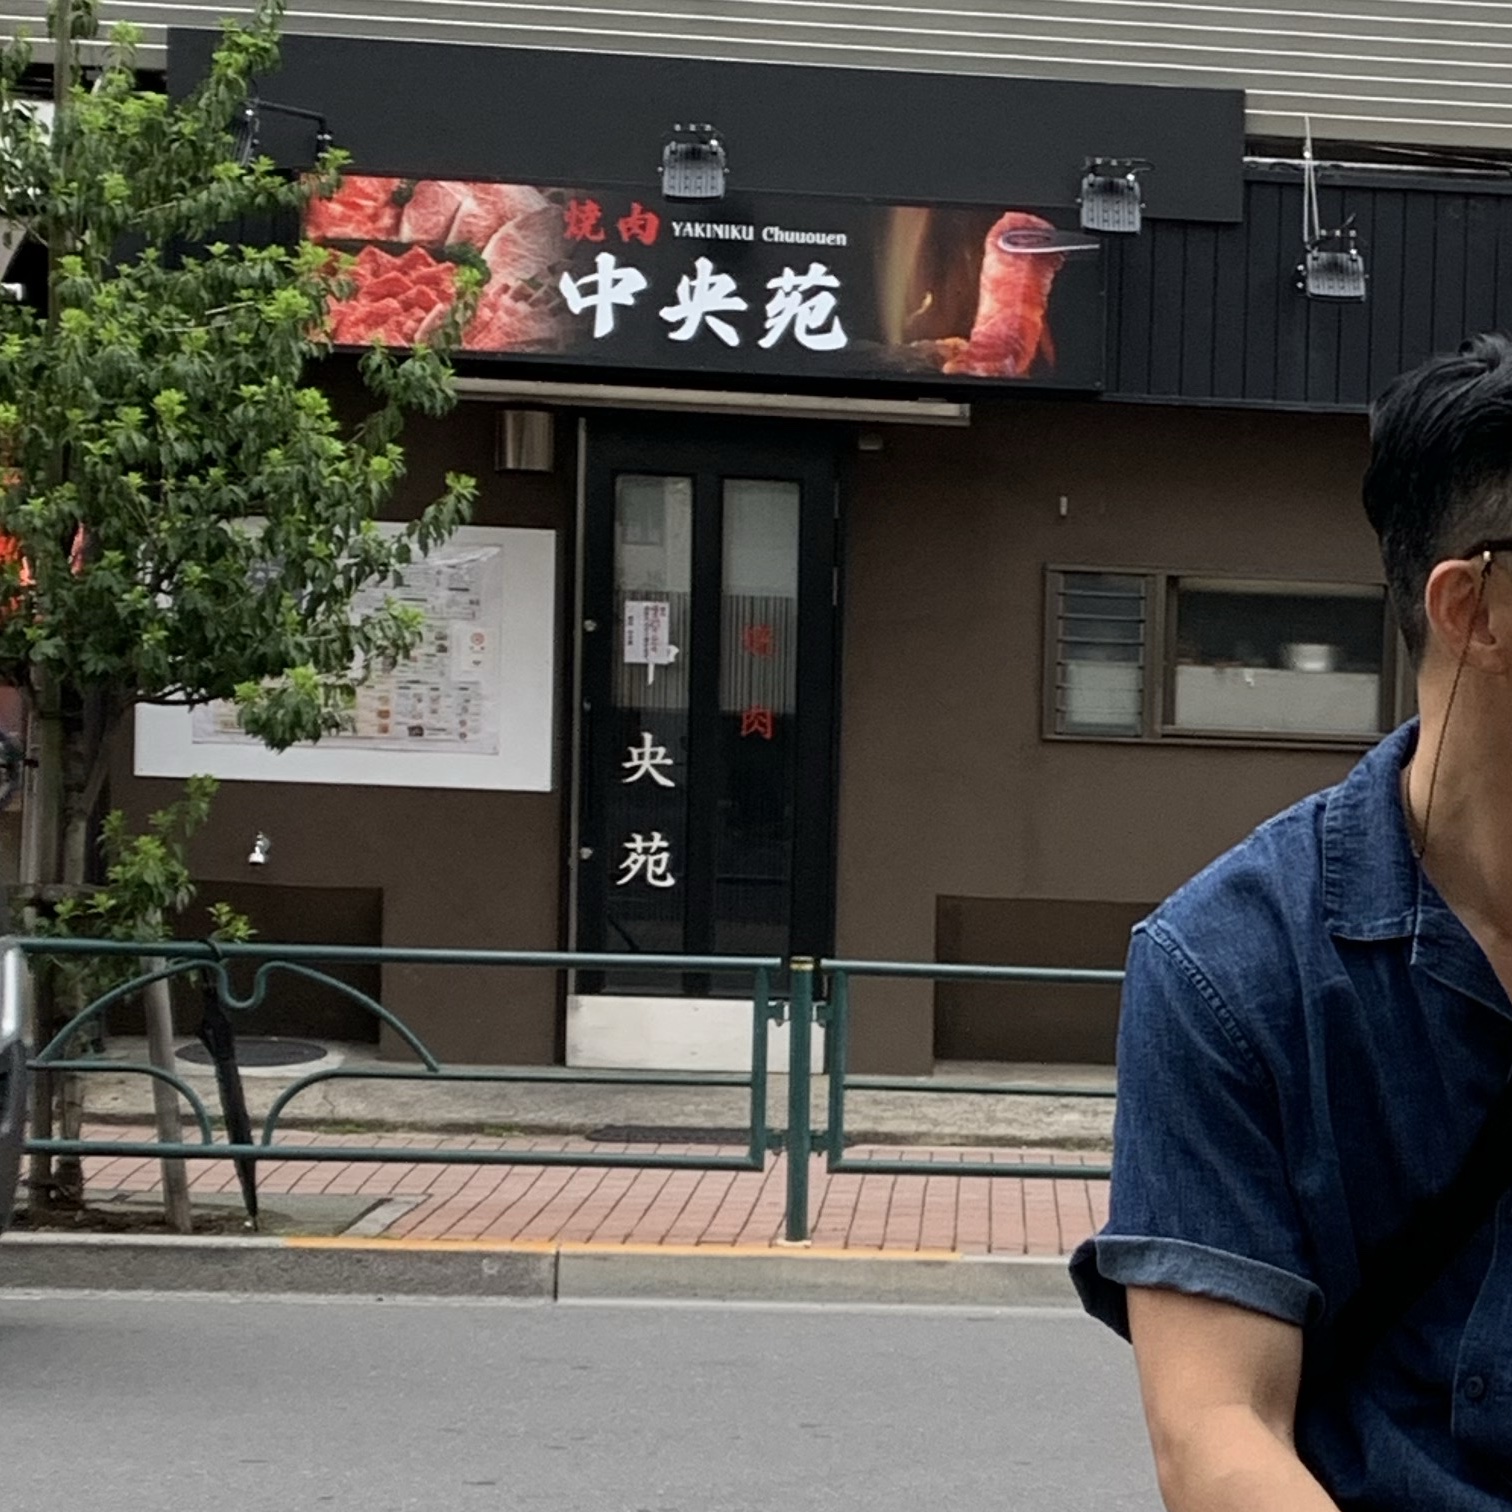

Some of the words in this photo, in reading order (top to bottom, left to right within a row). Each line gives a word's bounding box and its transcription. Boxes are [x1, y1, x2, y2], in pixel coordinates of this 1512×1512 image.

[563, 198, 661, 246] 焼肉
[671, 220, 755, 242] YAKINIKU
[761, 225, 848, 247] Chuuouen
[558, 251, 849, 351] 中央苑
